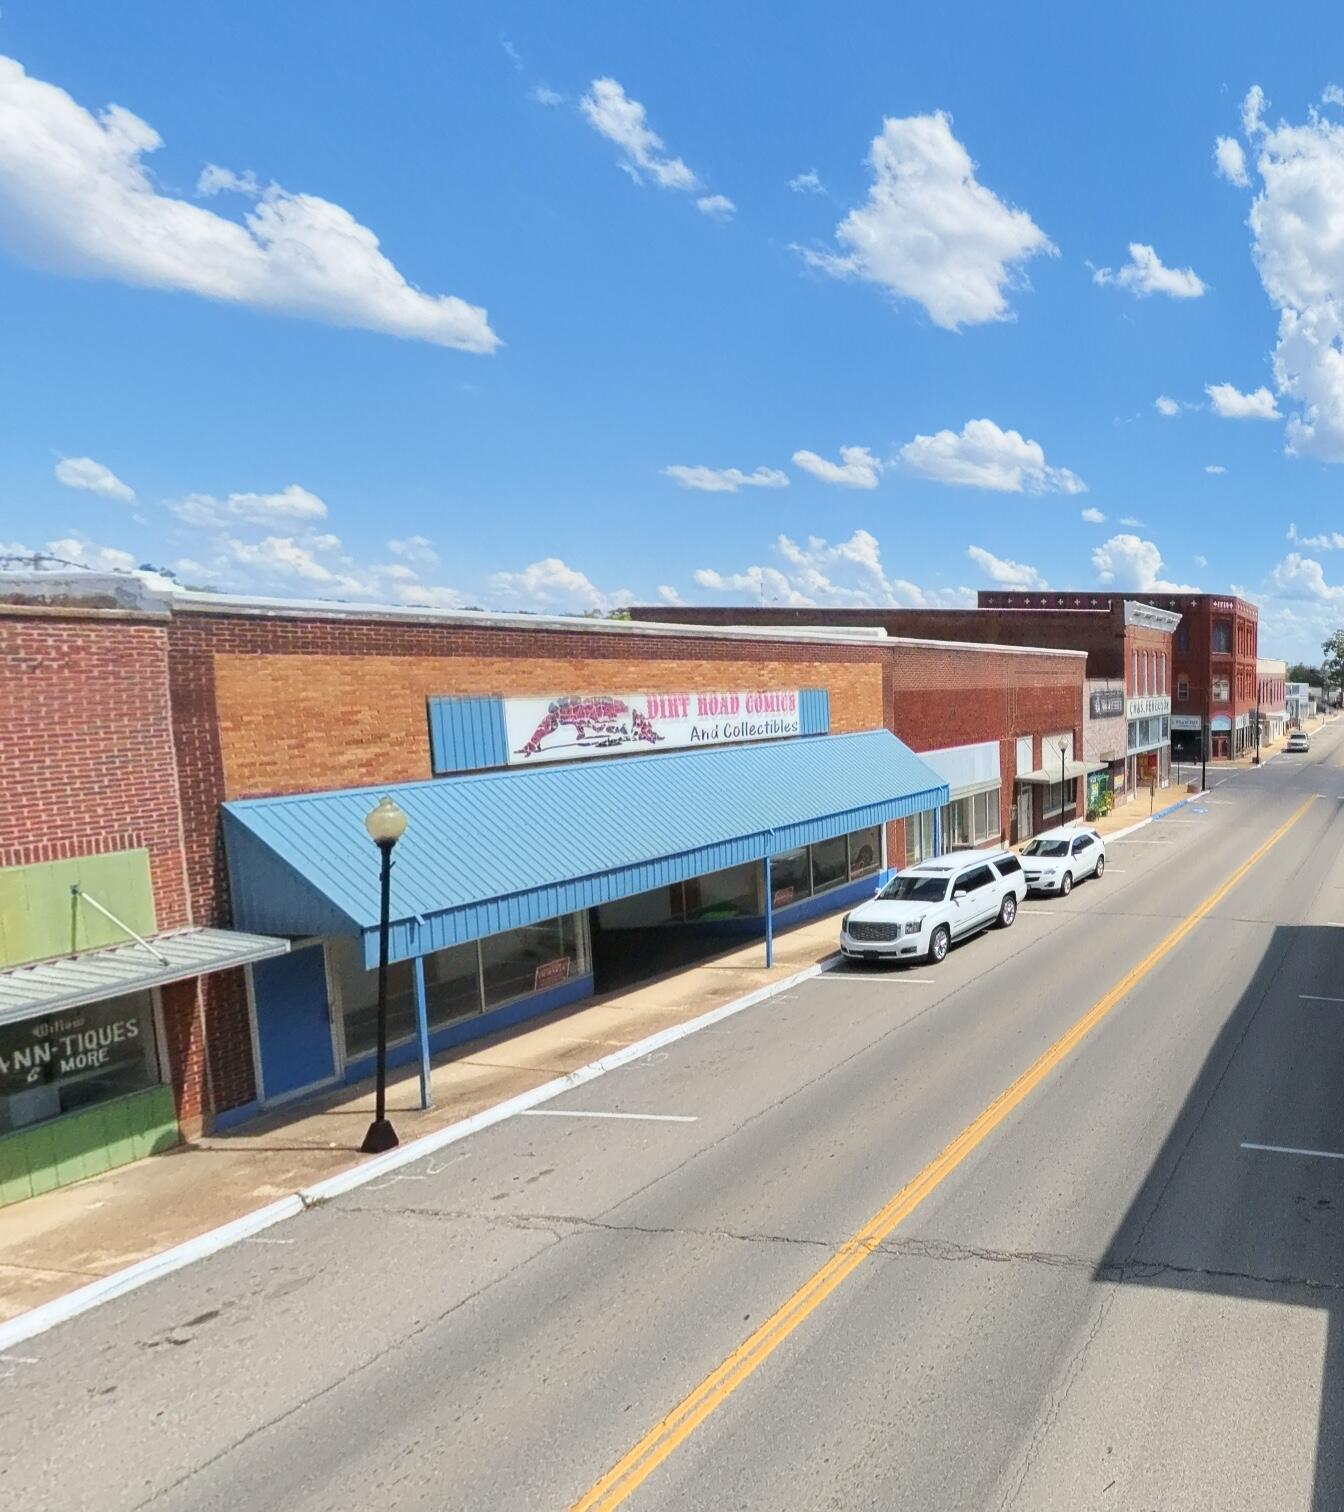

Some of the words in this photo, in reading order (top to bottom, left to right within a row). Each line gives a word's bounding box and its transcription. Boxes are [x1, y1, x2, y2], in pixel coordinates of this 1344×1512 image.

[646, 693, 689, 720] DIRT
[697, 693, 740, 716] ROAD
[745, 691, 796, 714] COMICS
[690, 724, 719, 742] And
[723, 719, 798, 739] Collectibles
[60, 1047, 110, 1073] MORE
